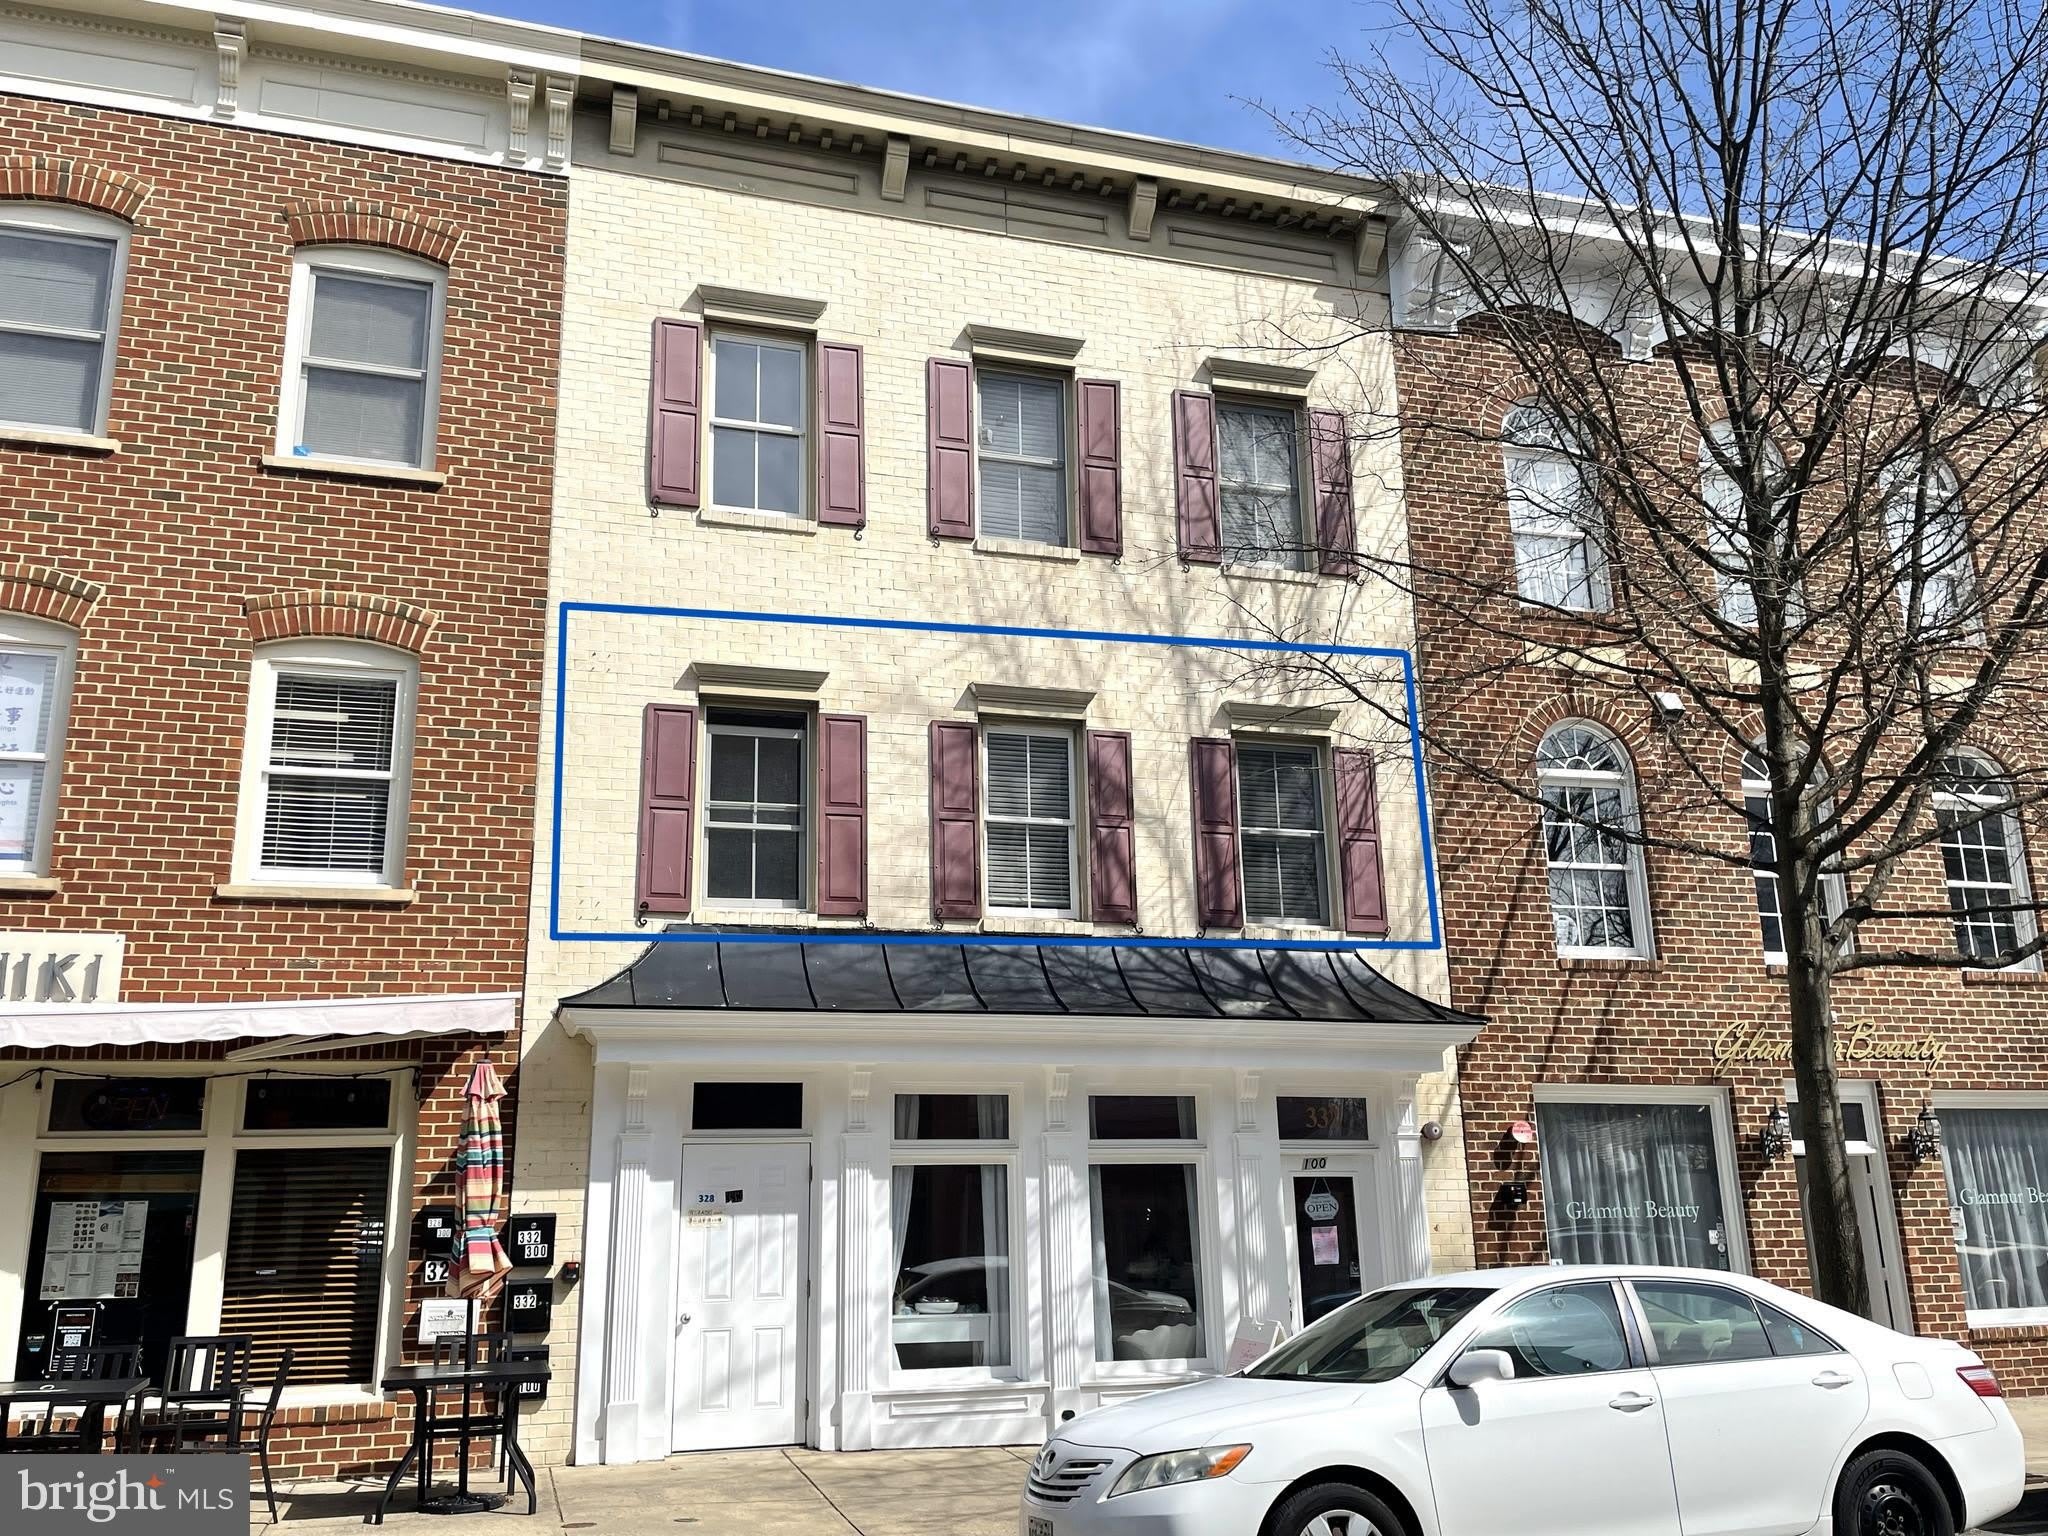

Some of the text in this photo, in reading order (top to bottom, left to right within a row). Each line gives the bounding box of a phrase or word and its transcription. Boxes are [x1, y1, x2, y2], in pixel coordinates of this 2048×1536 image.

[0, 707, 23, 725] 事
[1845, 1018, 1948, 1076] Beauty
[1304, 1157, 1326, 1170] 100
[699, 1195, 715, 1203] 328
[1307, 1203, 1337, 1212] OPEN
[1644, 1200, 1700, 1223] Beauty
[519, 1231, 540, 1243] 332
[526, 1245, 546, 1257] 300
[515, 1296, 536, 1308] 332
